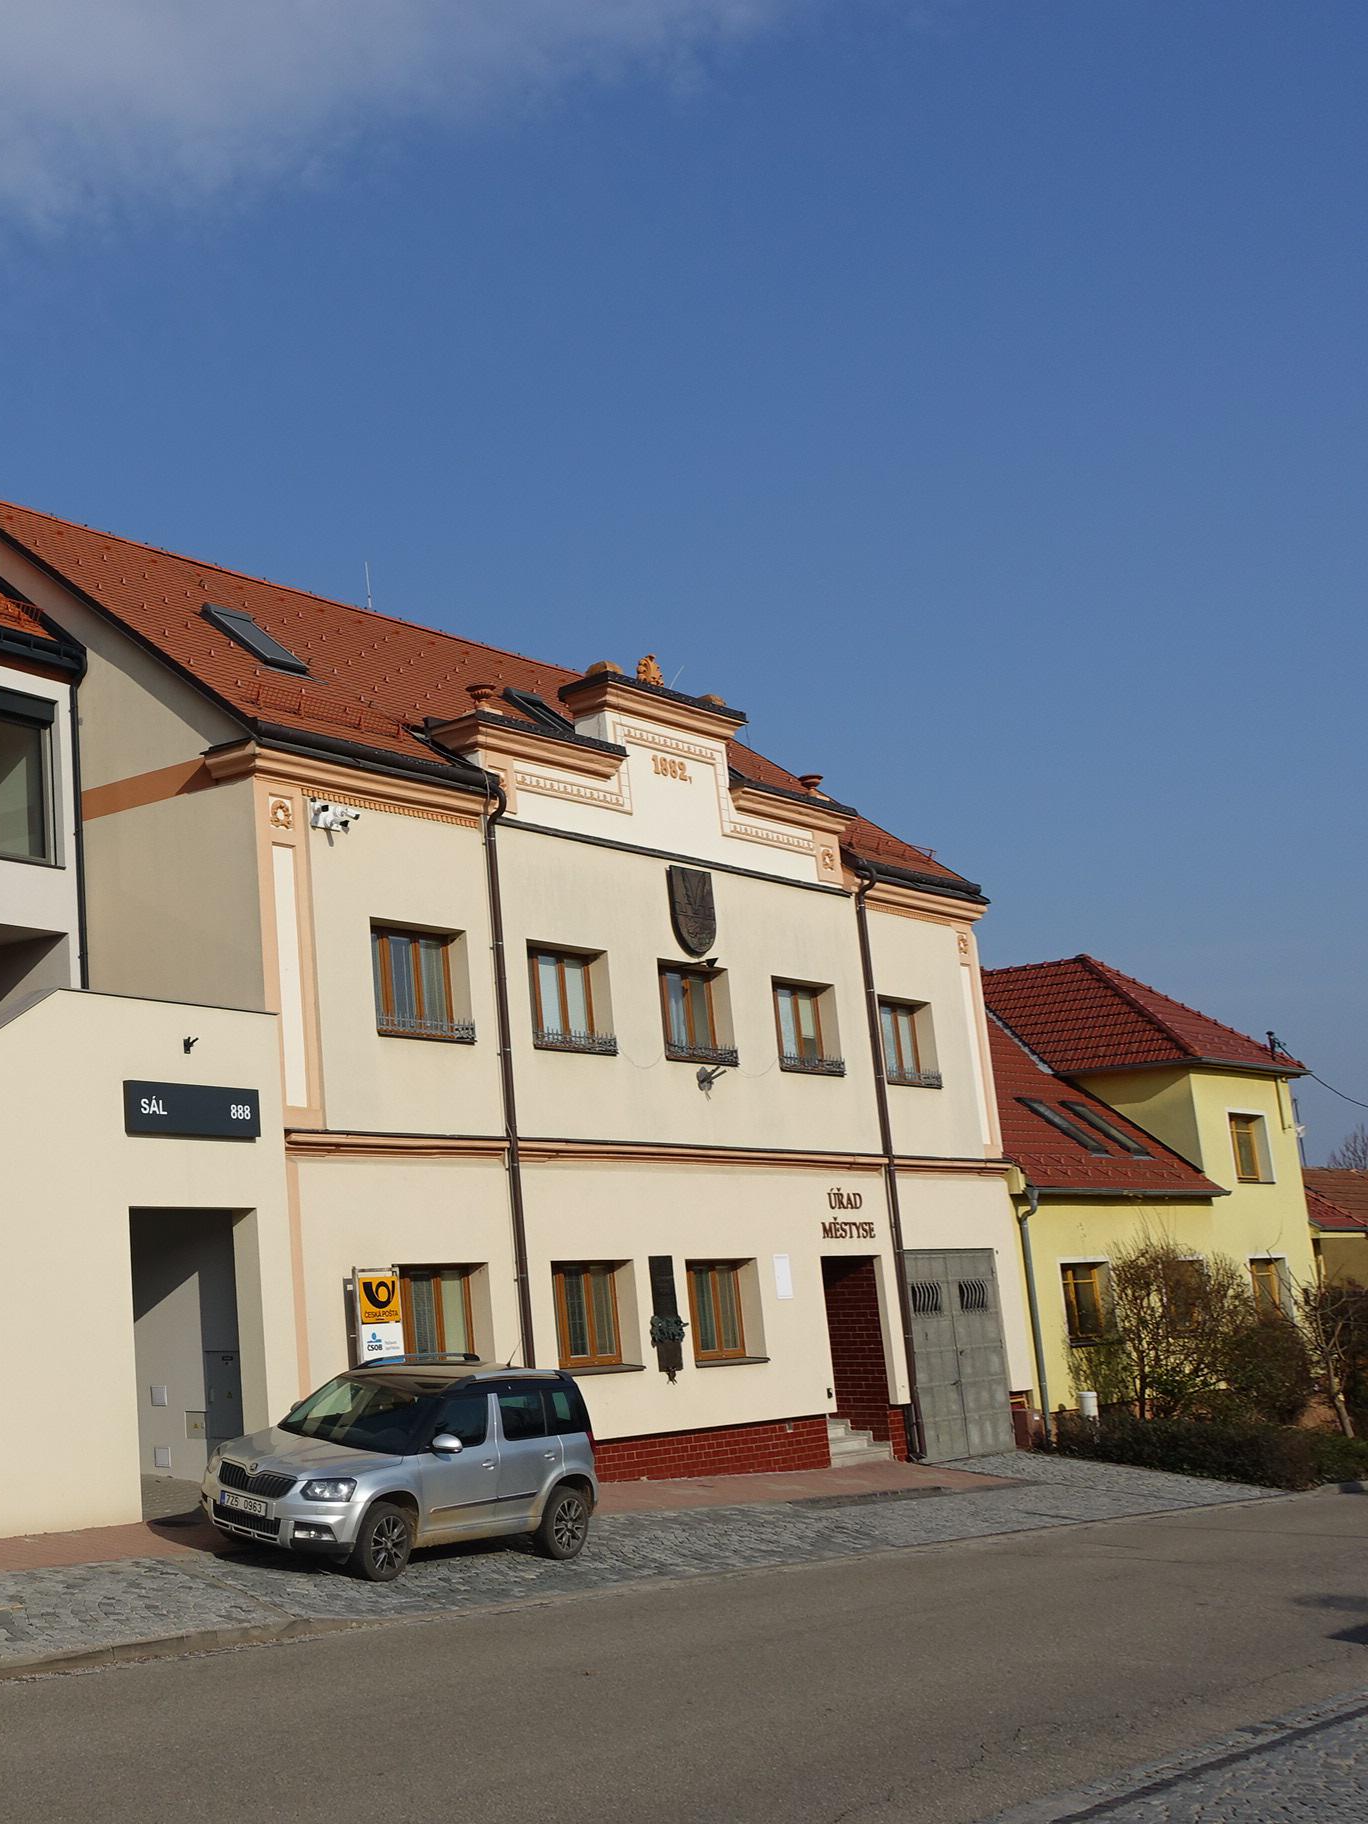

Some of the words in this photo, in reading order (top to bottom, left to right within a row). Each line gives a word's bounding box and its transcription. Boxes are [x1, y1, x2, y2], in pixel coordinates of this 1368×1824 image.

[140, 1095, 168, 1115] SÁL
[230, 1104, 251, 1120] 888
[826, 1187, 863, 1210] ÚŘAD
[820, 1216, 876, 1239] MĚSTYSE
